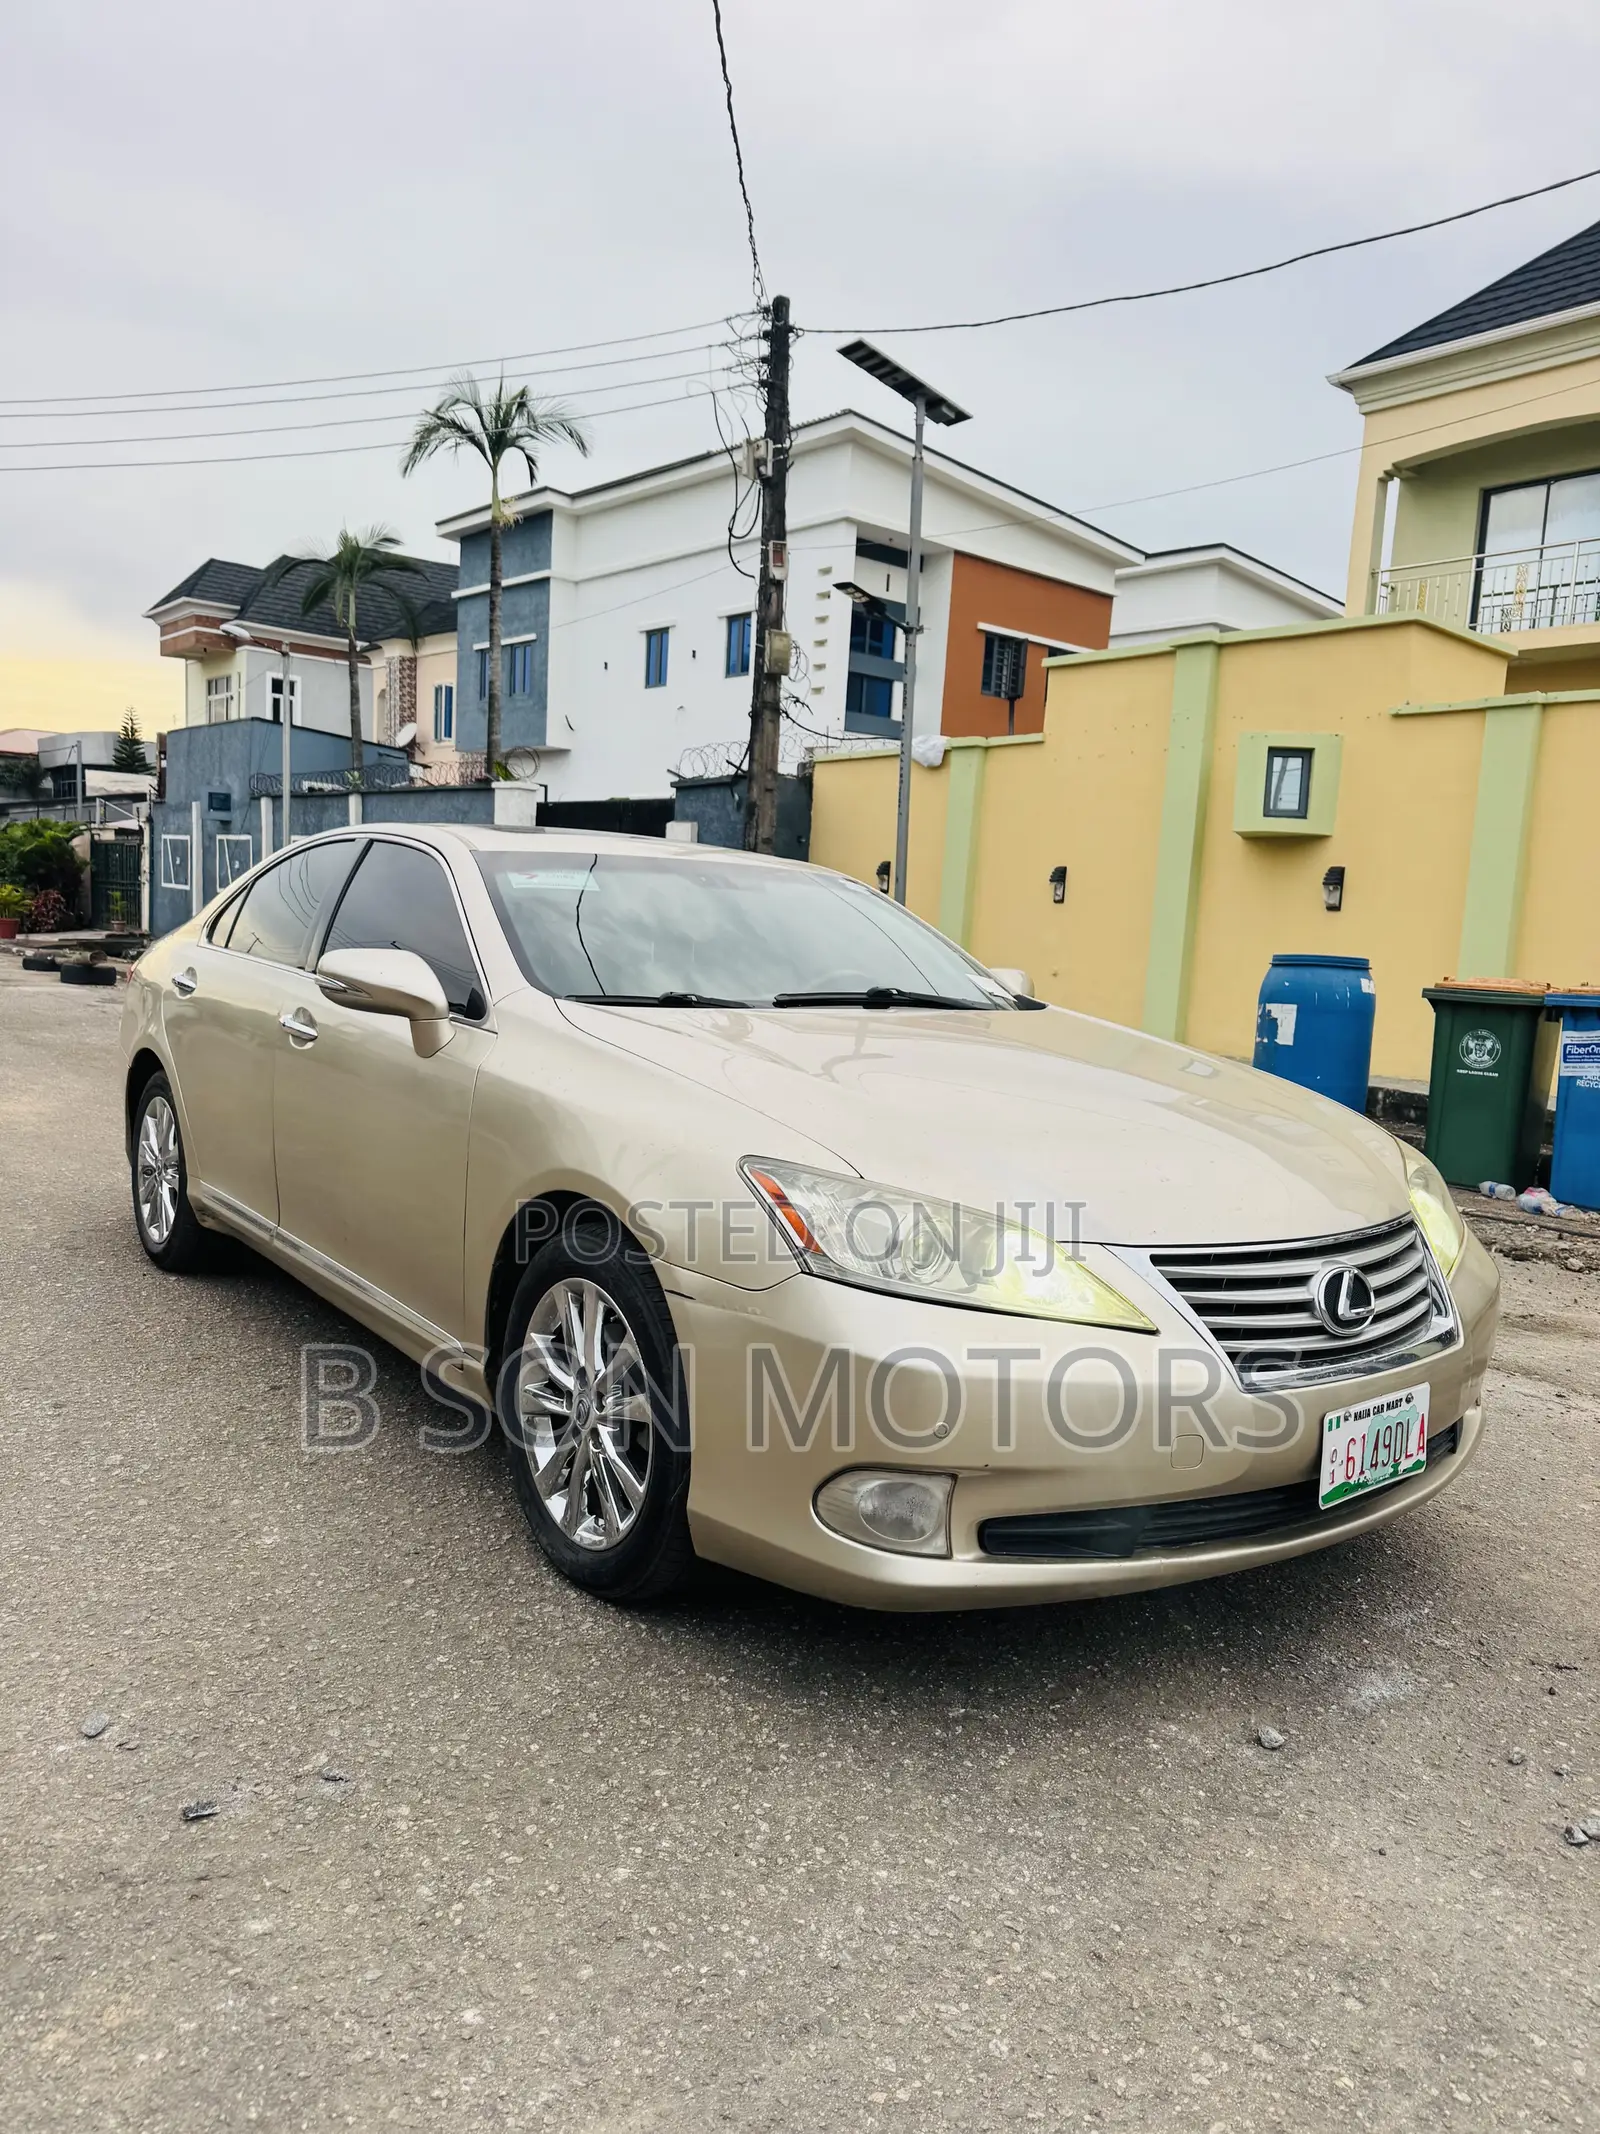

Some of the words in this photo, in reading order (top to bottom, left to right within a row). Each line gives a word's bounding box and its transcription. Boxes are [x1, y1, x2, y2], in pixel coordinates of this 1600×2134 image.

[1576, 1079, 1600, 1089] RECYC
[1372, 1404, 1385, 1416] CAR
[1386, 1398, 1403, 1412] MART
